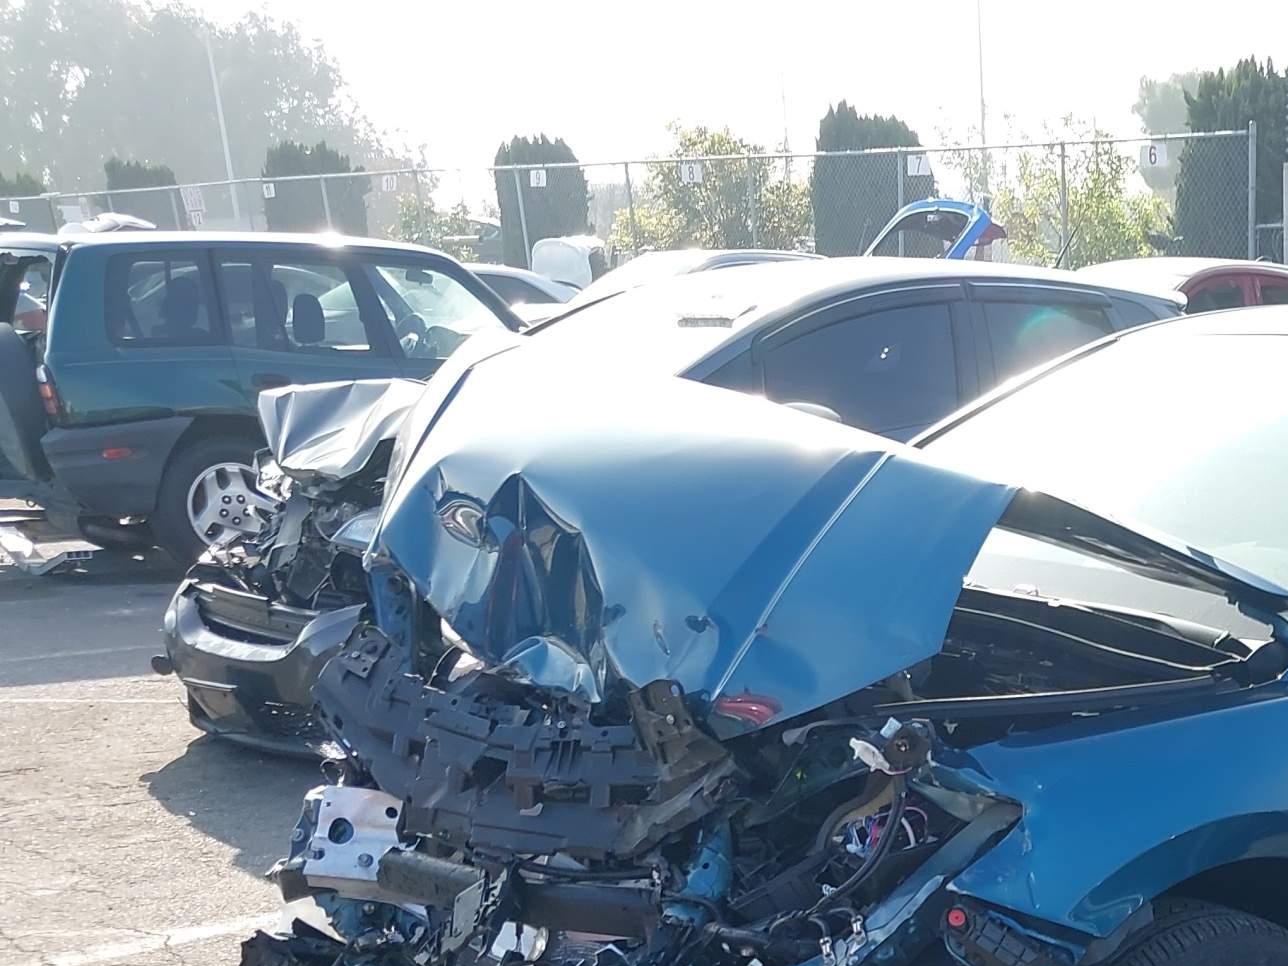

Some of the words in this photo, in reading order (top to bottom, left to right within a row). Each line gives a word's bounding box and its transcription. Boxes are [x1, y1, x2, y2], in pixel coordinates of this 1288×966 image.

[1149, 146, 1157, 165] 6
[916, 156, 923, 174] 7
[688, 166, 695, 181] 8
[385, 176, 394, 191] 10
